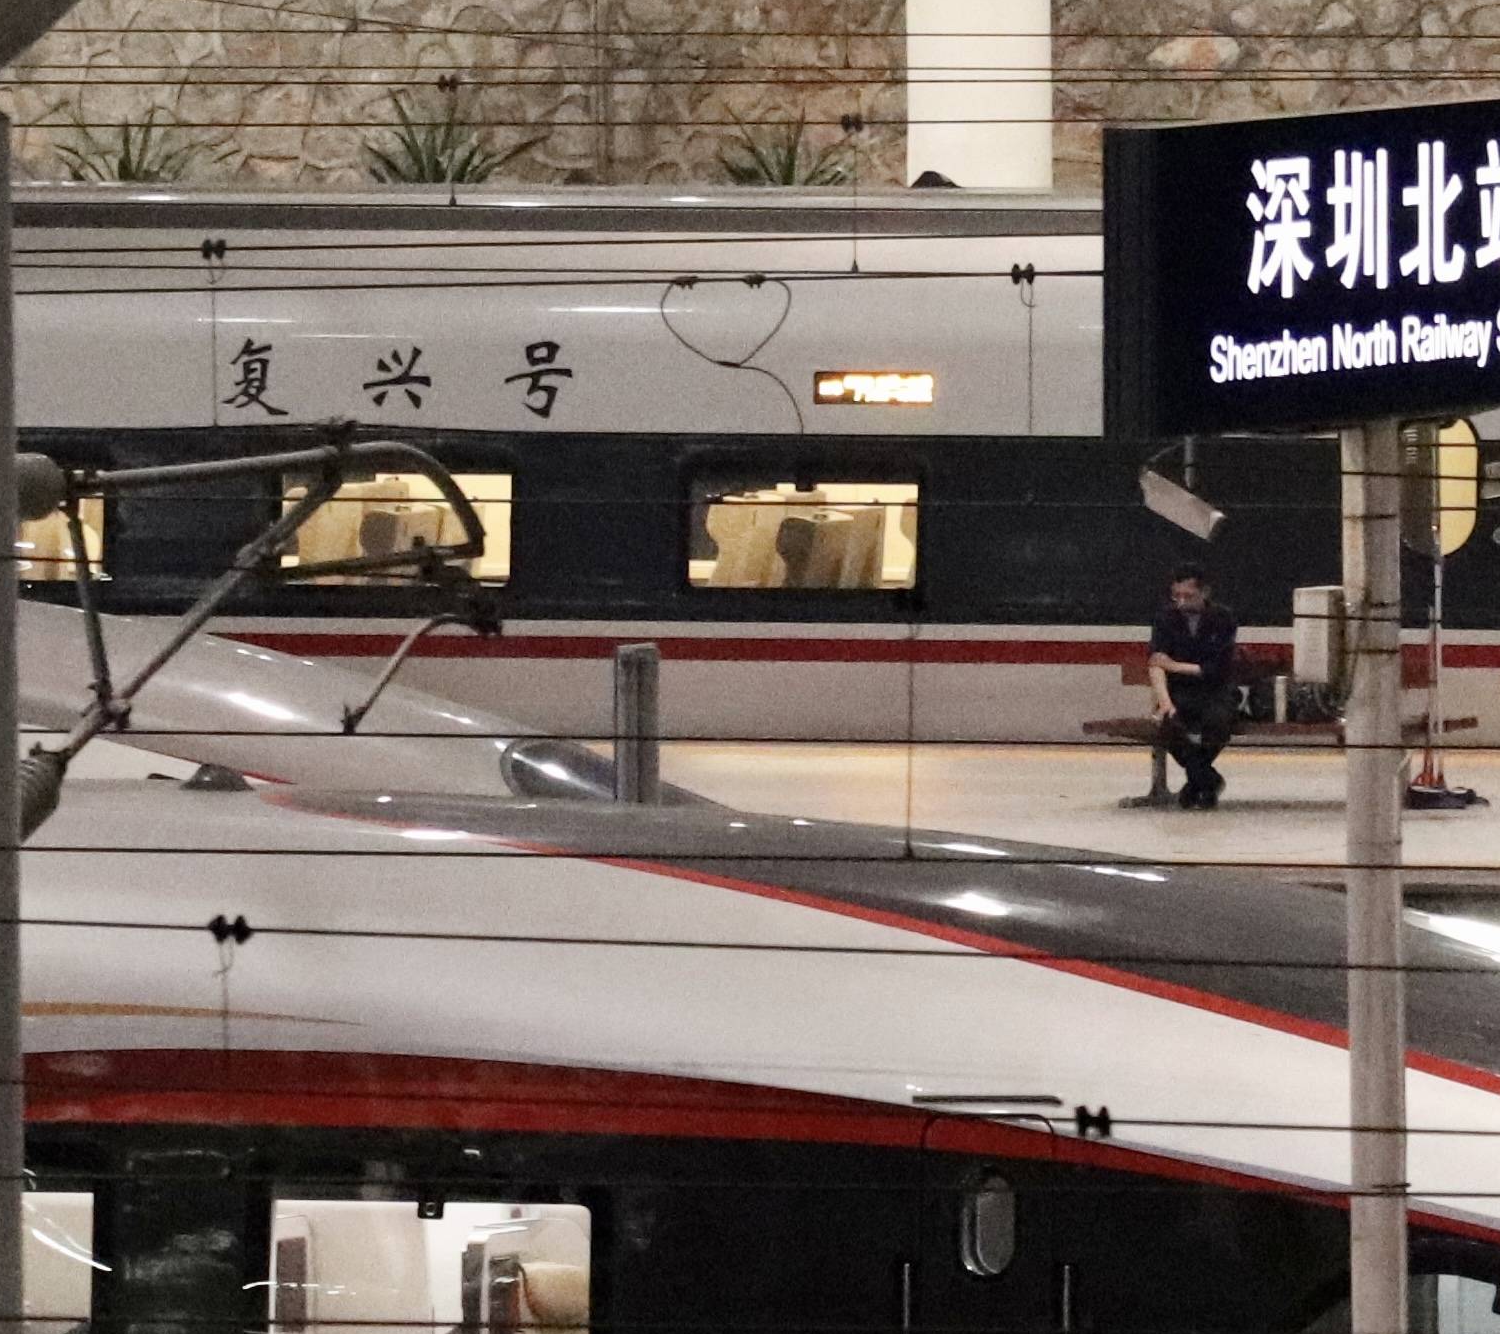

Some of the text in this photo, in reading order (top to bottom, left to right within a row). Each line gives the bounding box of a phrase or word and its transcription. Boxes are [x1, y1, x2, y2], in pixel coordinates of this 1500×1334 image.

[222, 336, 574, 419] 复兴号
[1209, 329, 1327, 383] Shenzhen
[1332, 319, 1397, 371] North
[1401, 313, 1493, 368] Railway
